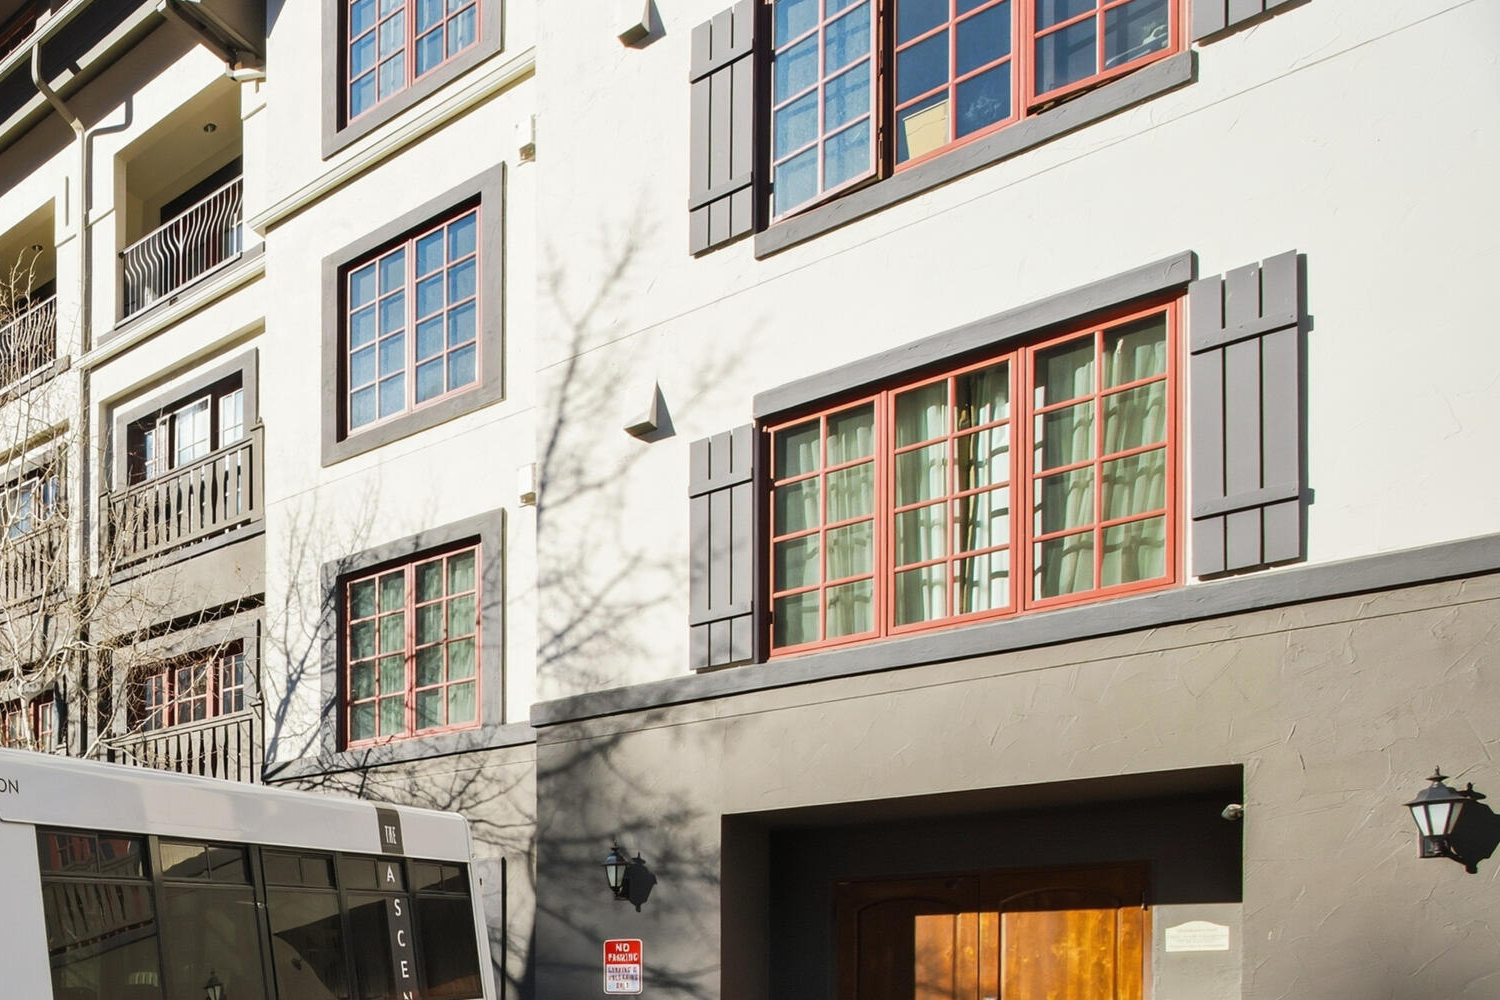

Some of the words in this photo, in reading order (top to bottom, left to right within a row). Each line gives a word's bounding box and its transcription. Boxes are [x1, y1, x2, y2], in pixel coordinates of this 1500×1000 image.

[384, 825, 396, 844] THE
[615, 943, 630, 952] NO
[608, 952, 639, 962] PARKING
